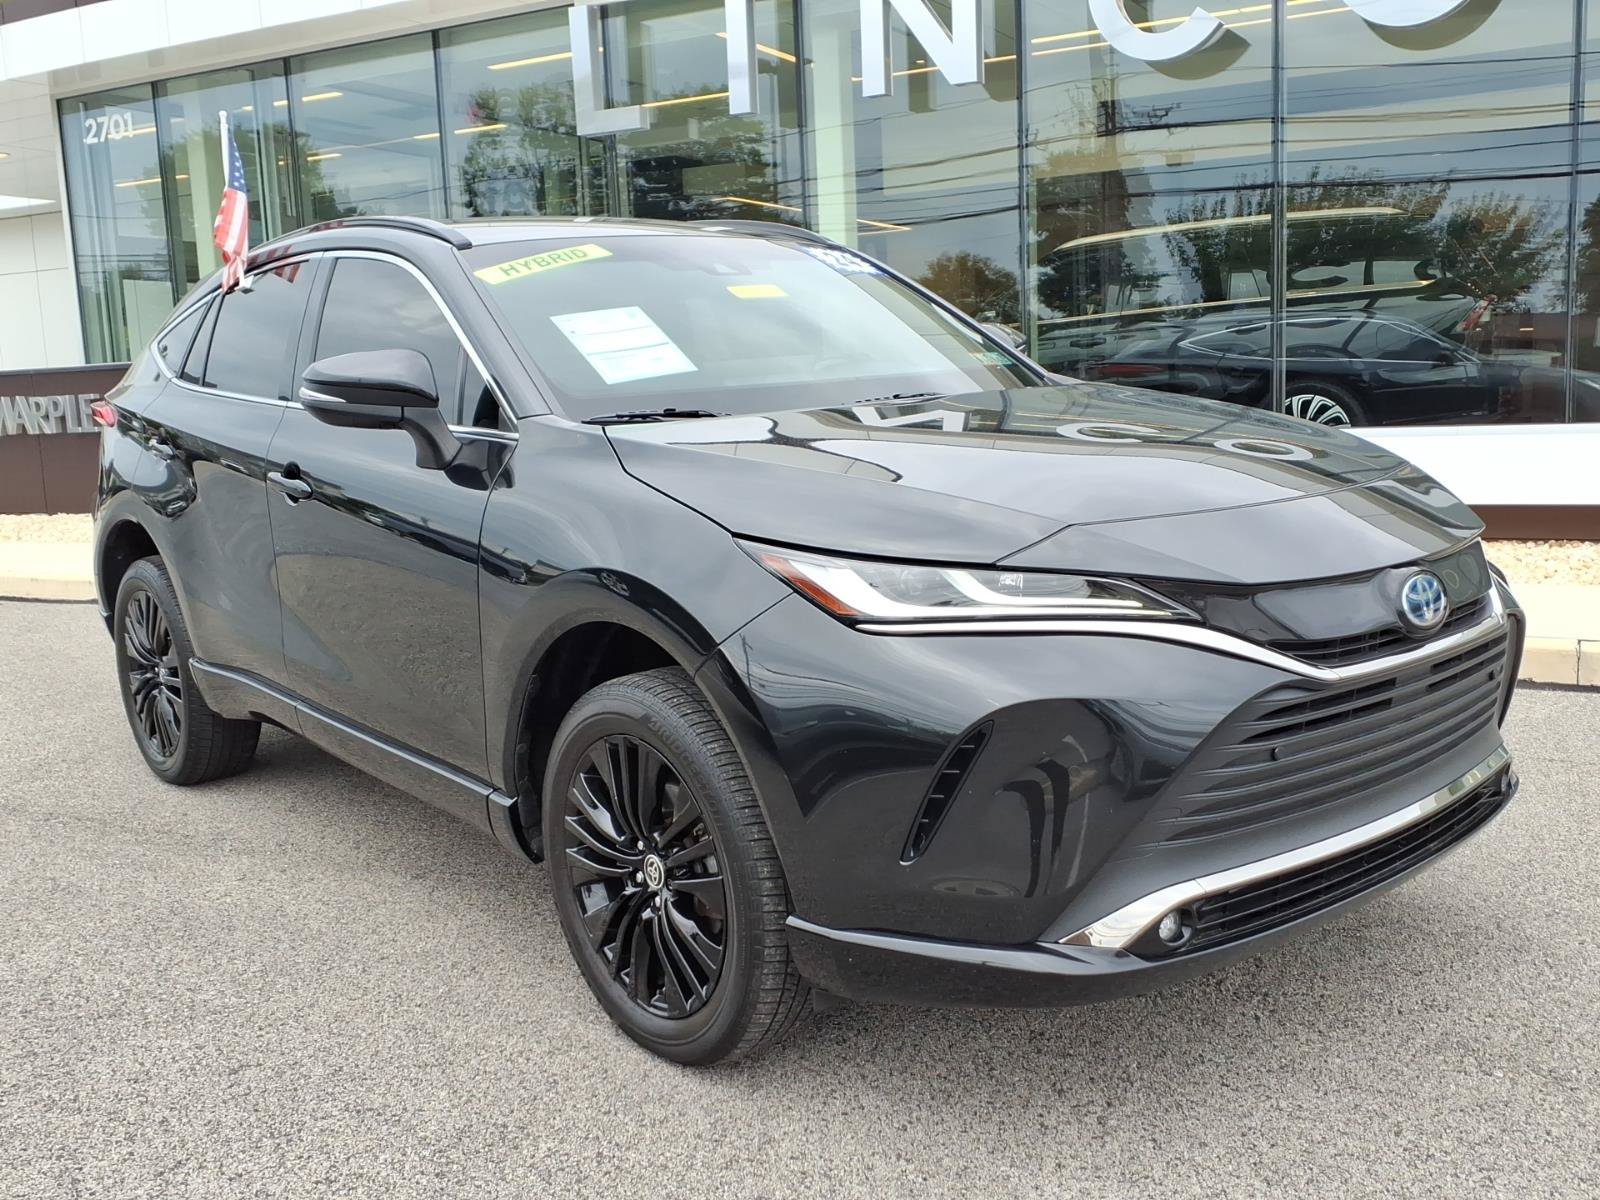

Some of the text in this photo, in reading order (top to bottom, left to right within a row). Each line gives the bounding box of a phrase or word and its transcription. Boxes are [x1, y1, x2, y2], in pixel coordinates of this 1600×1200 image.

[569, 0, 1470, 136] LIN
[83, 111, 133, 144] 2701
[499, 248, 588, 277] HYBRID
